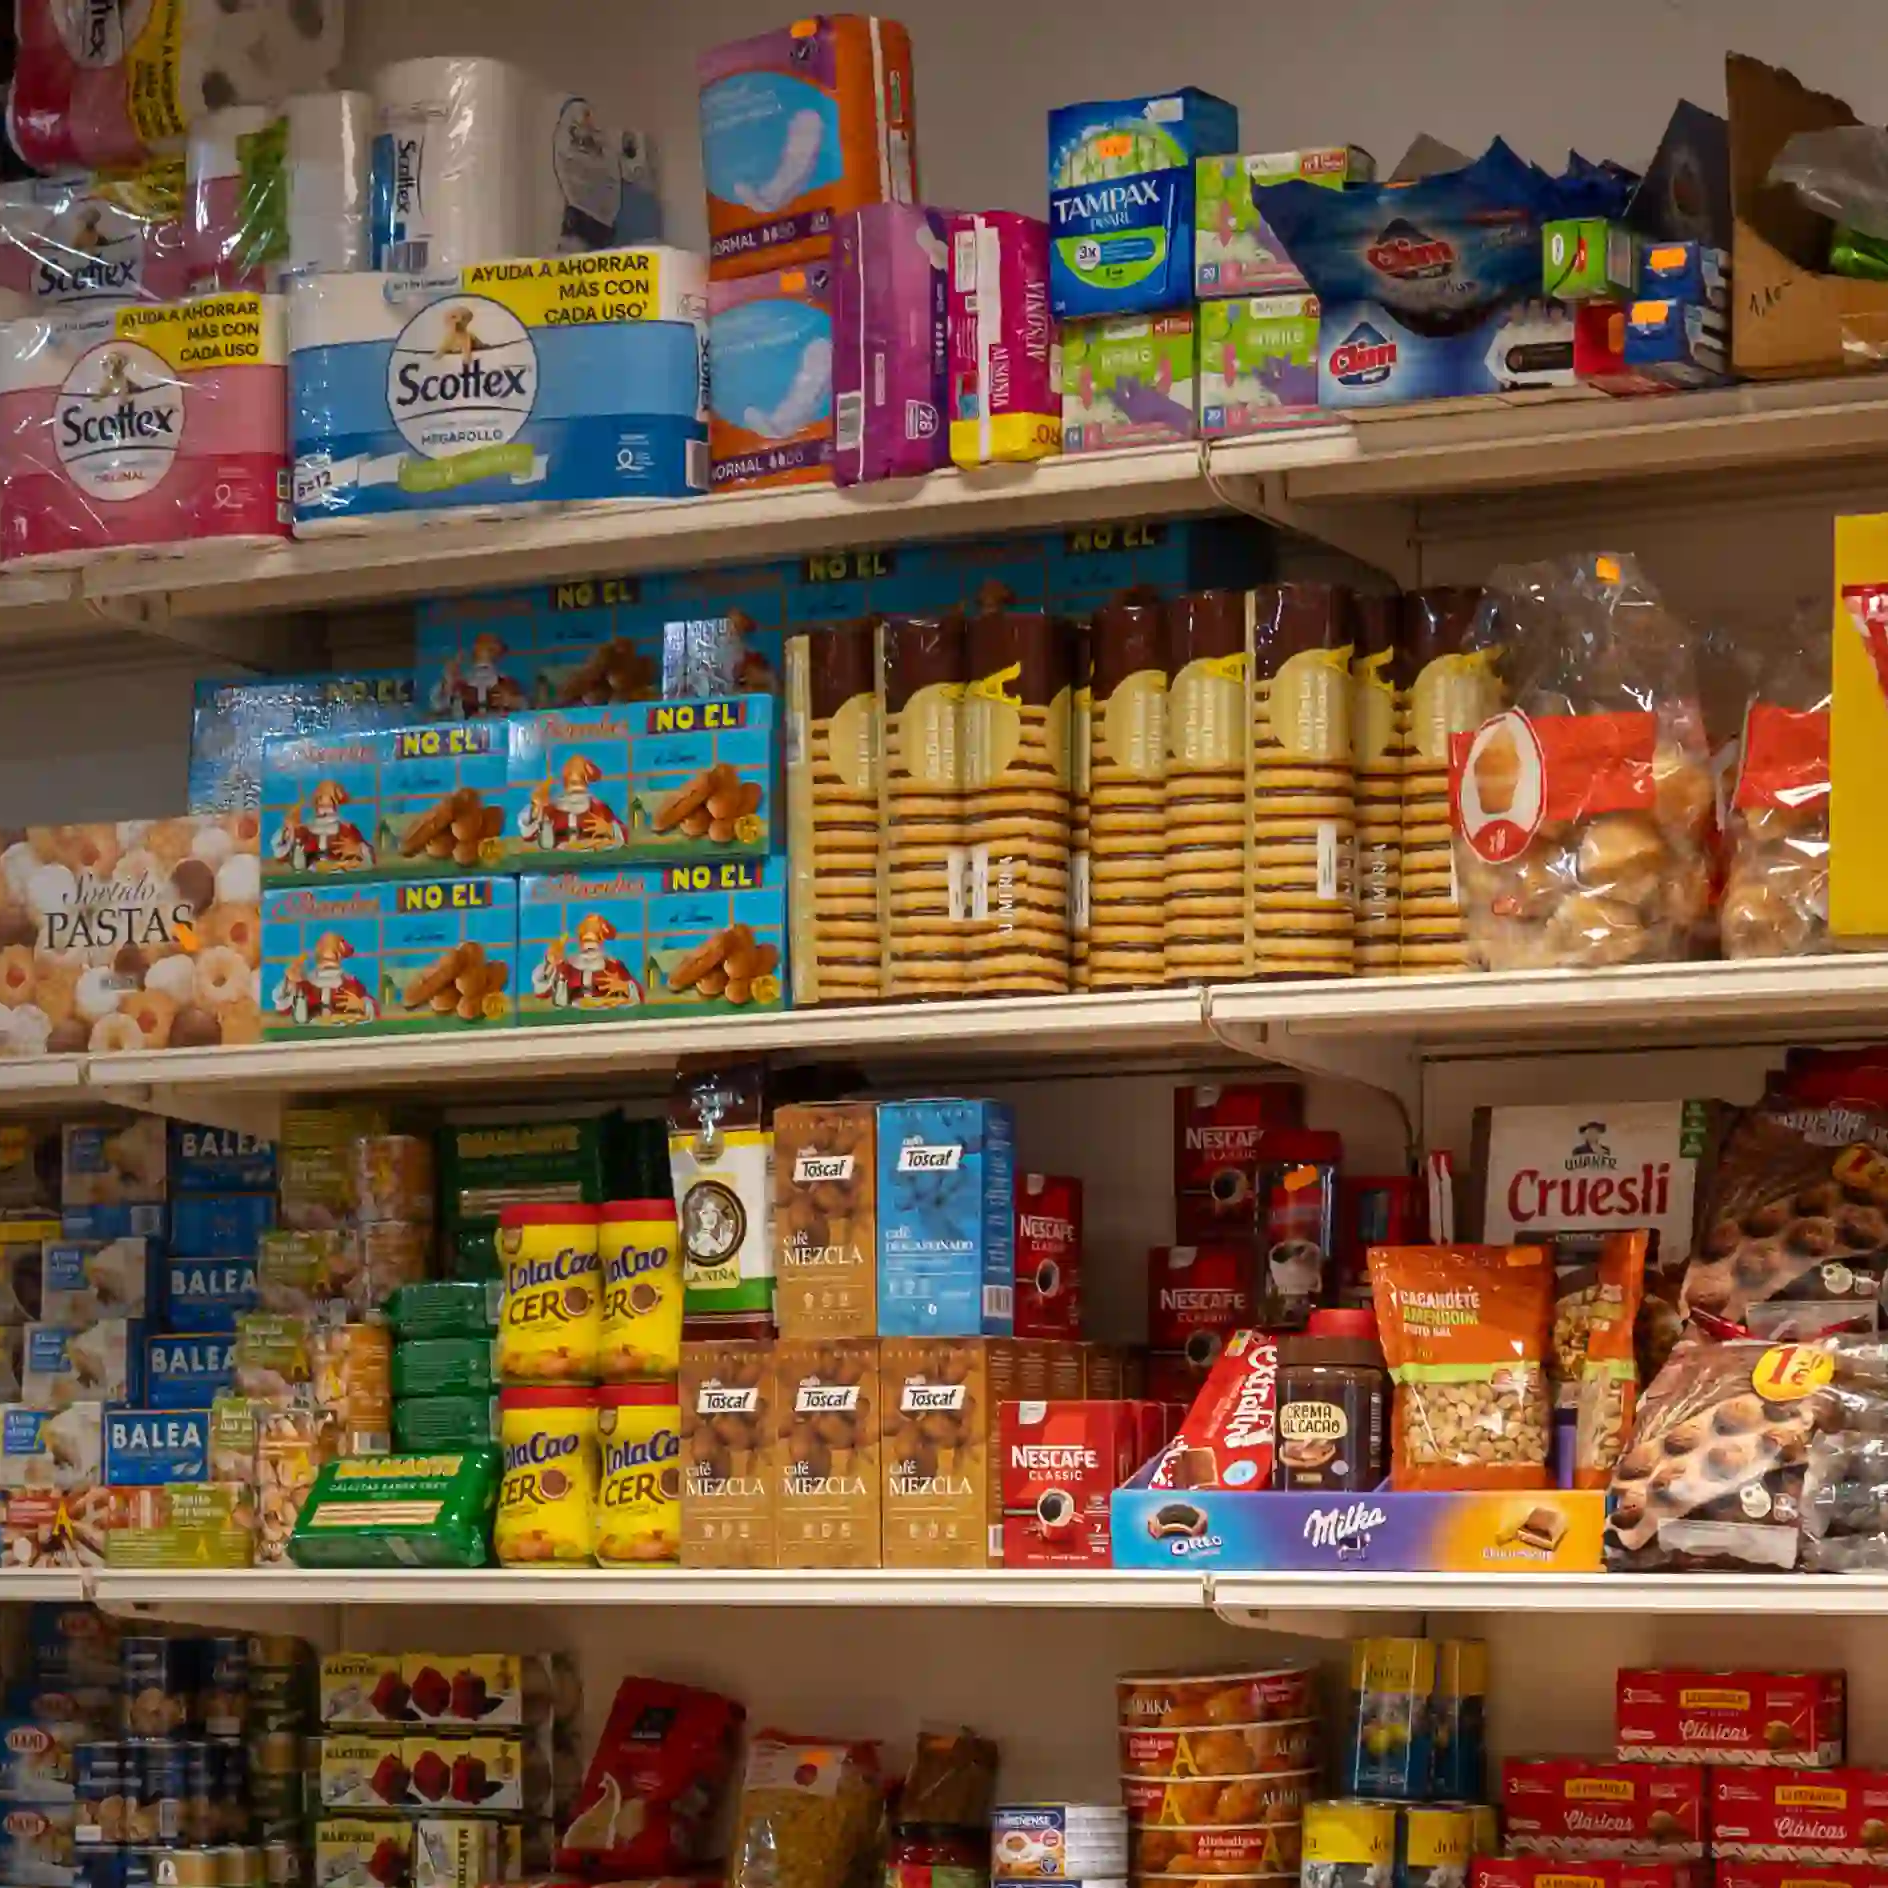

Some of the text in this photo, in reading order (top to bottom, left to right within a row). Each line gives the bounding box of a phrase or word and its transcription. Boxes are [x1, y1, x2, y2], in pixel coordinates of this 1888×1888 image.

[1053, 177, 1161, 225] TAMPAX
[470, 254, 649, 282] AYUDA A AHORRAR
[559, 278, 649, 300] MÁS CON
[184, 301, 259, 322] AHORRAR
[187, 321, 259, 339] MÁS CON
[180, 341, 259, 362] CADA USO
[397, 362, 526, 406] Scottex
[61, 394, 175, 450] Scottex
[655, 704, 736, 732] NO EL
[404, 728, 477, 755] NO EL
[672, 864, 753, 892] NO EL
[406, 883, 482, 911] NO EL
[44, 903, 194, 951] PASTAS
[906, 1147, 953, 1168] Toscaf
[1508, 1162, 1671, 1223] Cruesli
[783, 1246, 863, 1267] MEZCLA
[170, 1269, 257, 1295] BALEA
[703, 1389, 750, 1410] Toscaf
[1286, 1403, 1333, 1420] CREMA
[112, 1422, 203, 1449] BALEA
[686, 1461, 712, 1479] café
[1029, 1469, 1083, 1482] CLASSIC
[685, 1475, 766, 1497] MEZCLA
[1304, 1502, 1387, 1548] Milka
[1170, 1533, 1223, 1555] OREO
[1678, 1718, 1752, 1742] Clásicas
